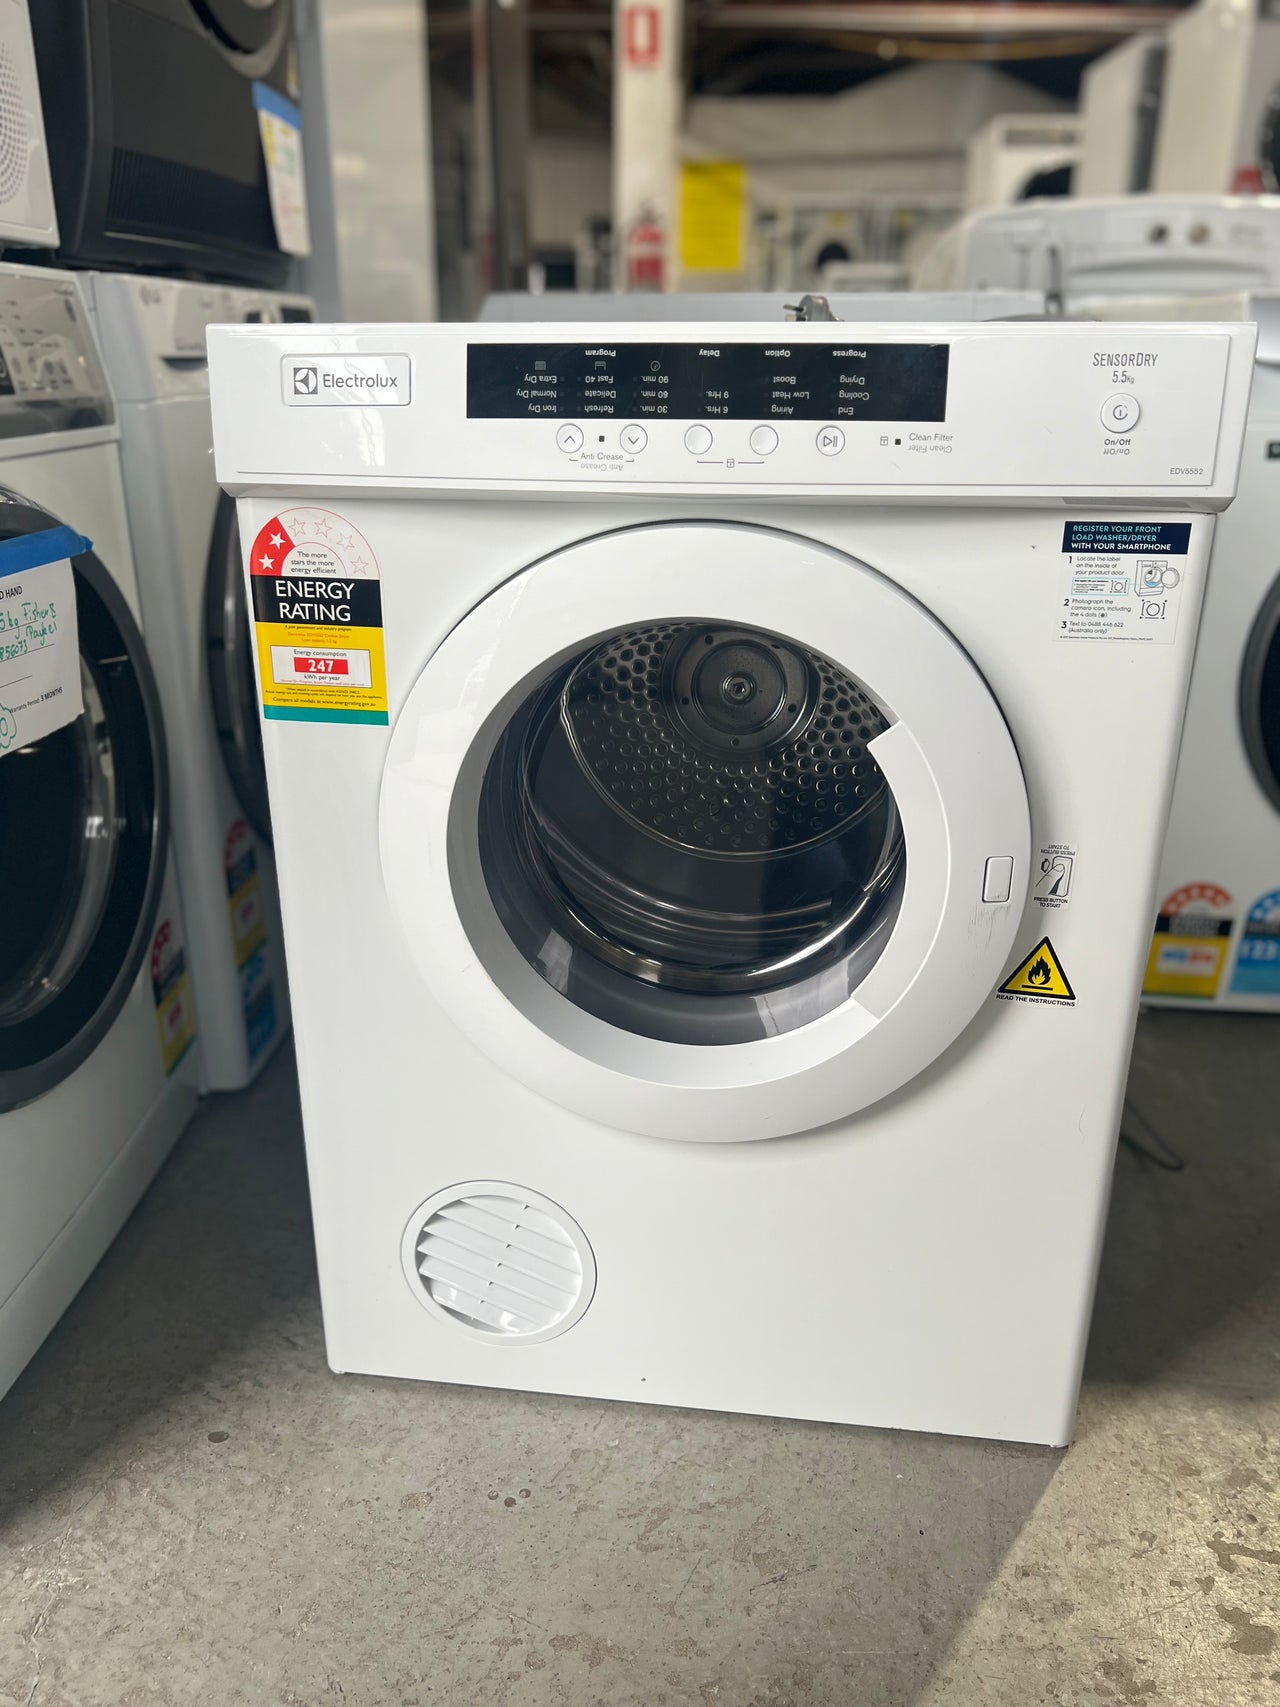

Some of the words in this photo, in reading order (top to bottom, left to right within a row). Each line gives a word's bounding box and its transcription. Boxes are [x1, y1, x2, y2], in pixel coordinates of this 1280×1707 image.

[585, 349, 616, 357] Program
[699, 349, 720, 358] Delay
[765, 350, 790, 358] Option
[832, 350, 866, 358] Progress
[322, 373, 398, 388] Electrolux
[524, 374, 537, 383] Dry
[538, 375, 557, 383] Extra
[585, 375, 596, 383] 40
[597, 375, 614, 383] Fast
[658, 375, 669, 383] 90
[773, 376, 796, 384] Boost
[840, 375, 865, 384] Drying
[516, 388, 529, 398] Dry
[530, 390, 557, 398] Normal
[584, 390, 616, 398] Delicate
[658, 390, 668, 398] 60
[793, 391, 810, 399] Low
[839, 391, 870, 400] Cooling
[528, 403, 541, 412] Dry
[542, 404, 557, 413] Iron
[584, 404, 614, 413] Refresh
[657, 405, 668, 413] 30
[771, 405, 794, 414] Airing
[838, 406, 854, 415] End
[908, 433, 933, 441] Clean
[930, 445, 952, 453] Clean
[597, 452, 623, 460] Crease
[6, 585, 22, 598] HAND
[275, 580, 355, 600] ENERGY
[279, 602, 351, 621] RATING
[294, 649, 312, 657] Energy
[308, 660, 334, 672] 247
[44, 686, 62, 700] MONTHS
[1028, 997, 1075, 1007] INSTRUCTIONS
